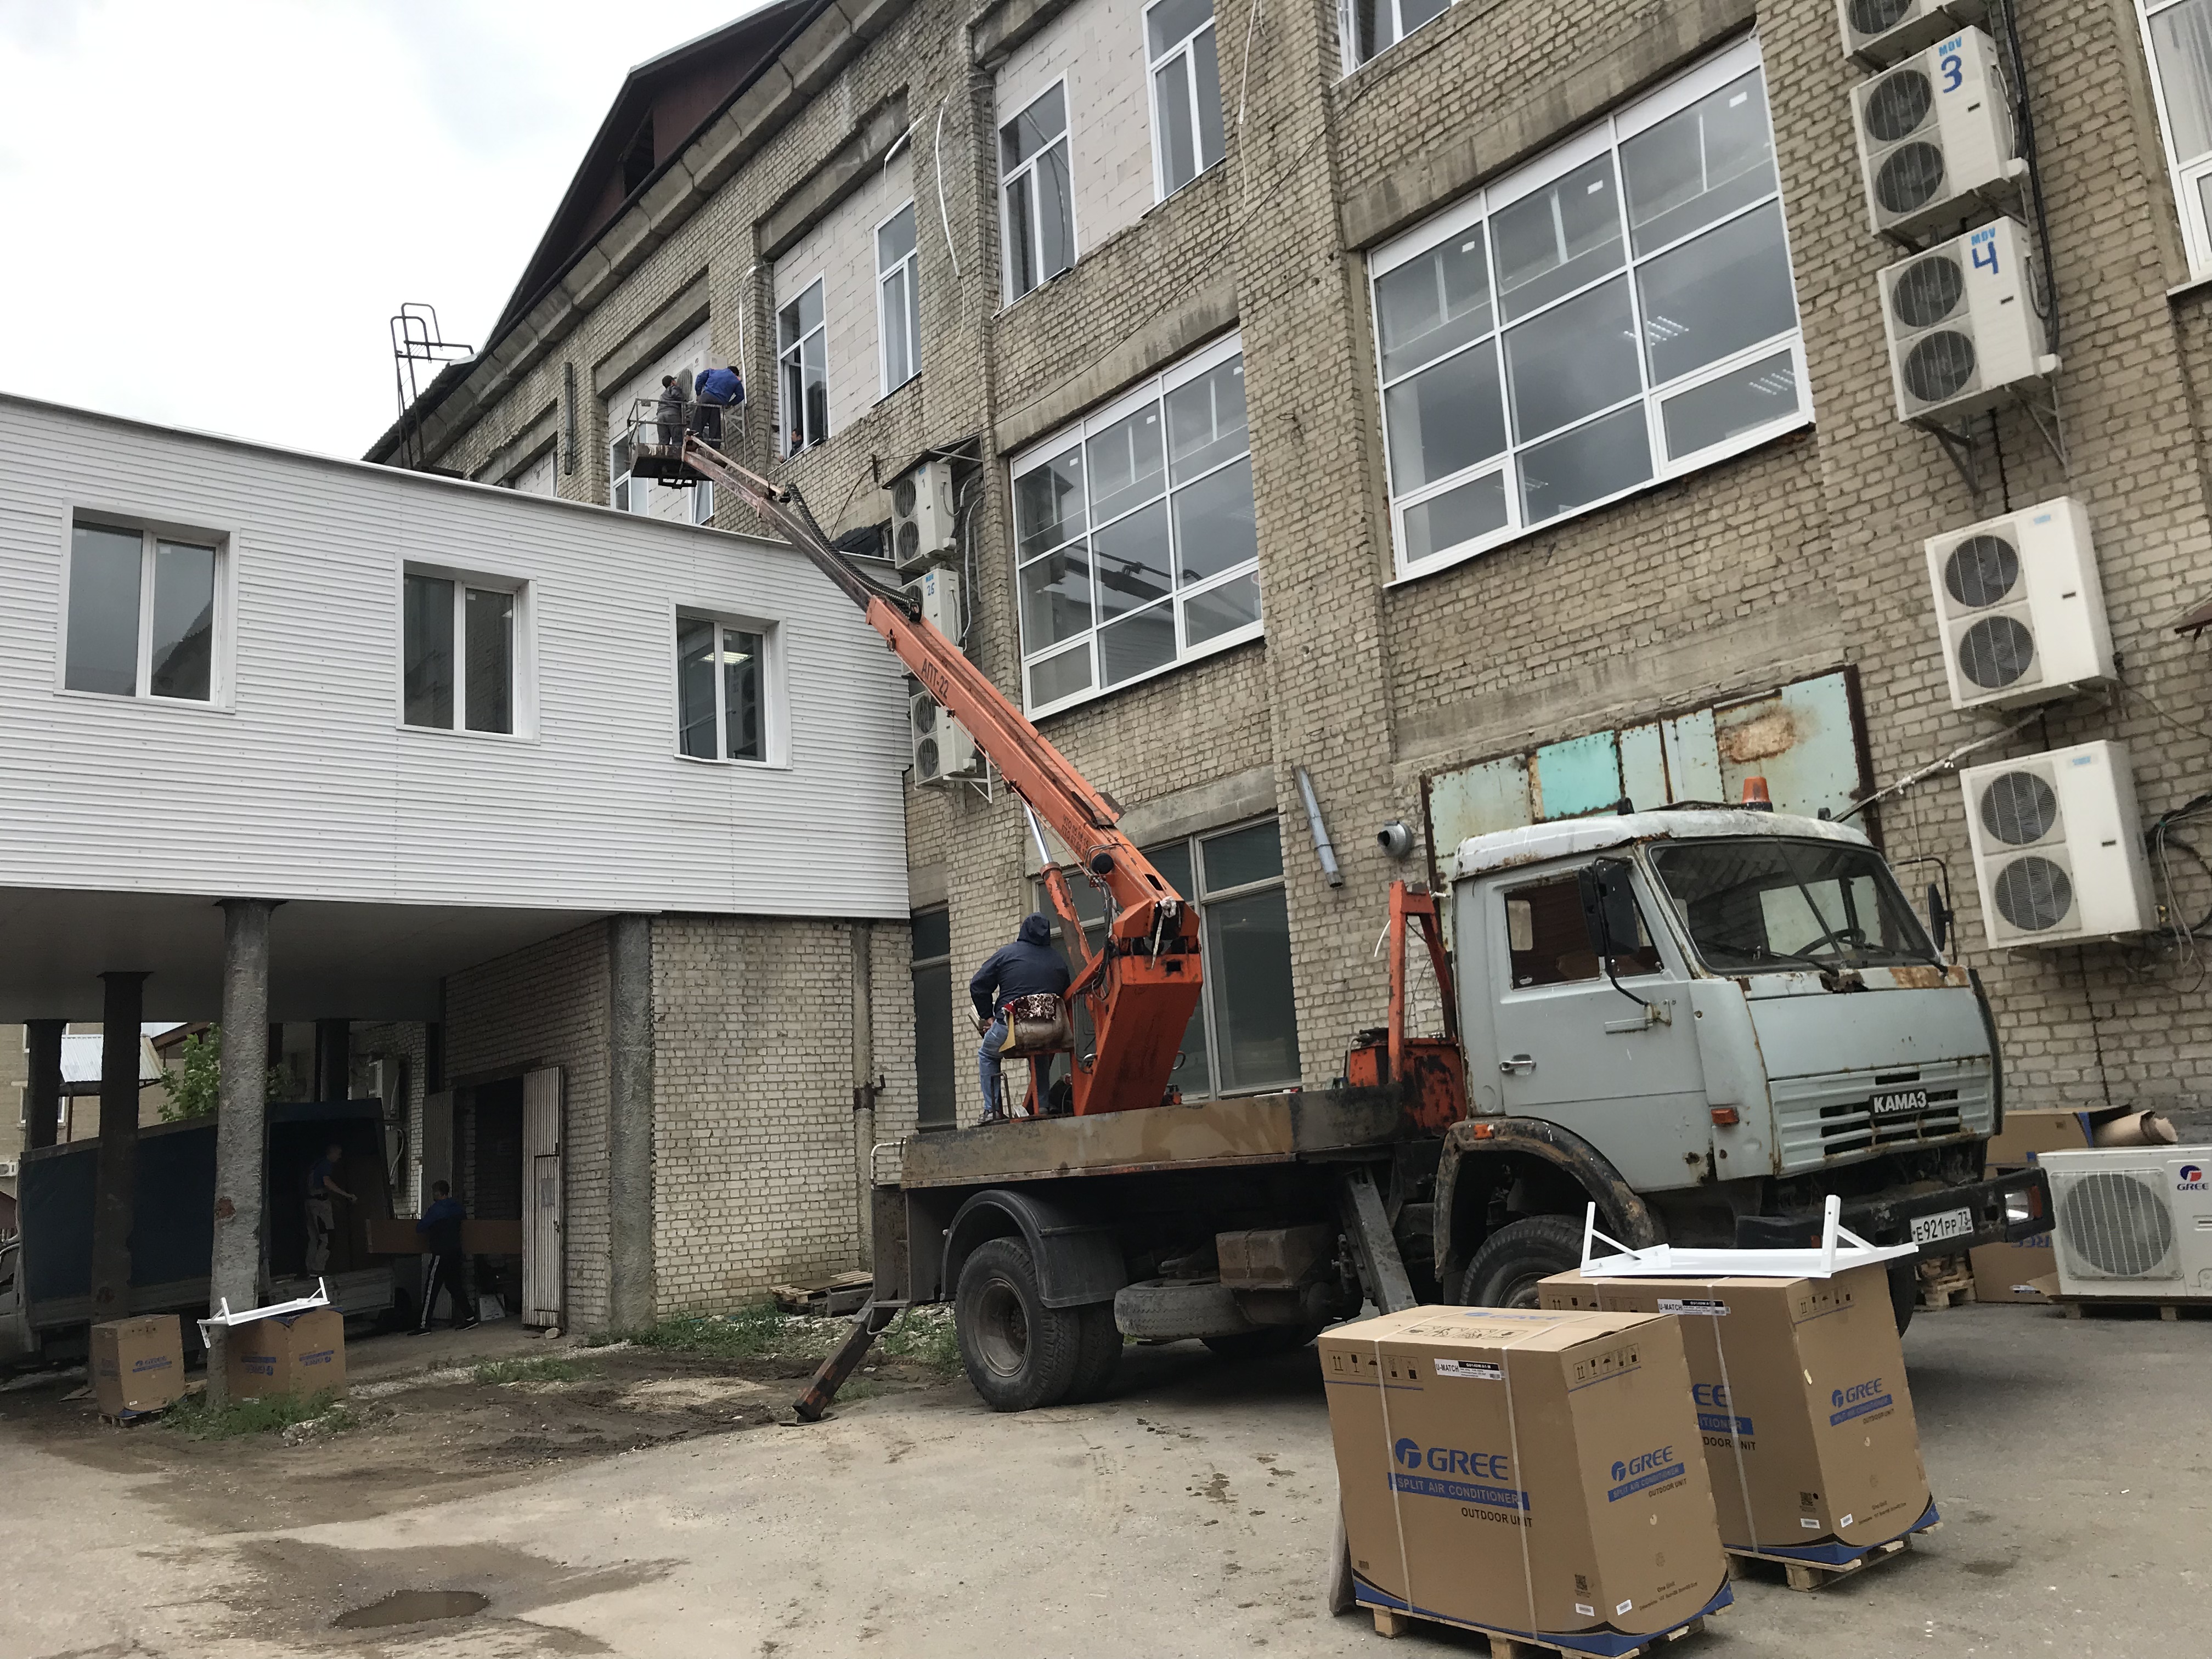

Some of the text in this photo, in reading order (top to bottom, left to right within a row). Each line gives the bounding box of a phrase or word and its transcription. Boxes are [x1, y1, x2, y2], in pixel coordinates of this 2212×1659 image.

[1941, 55, 1963, 93] 3
[1971, 241, 1999, 275] 4
[1874, 1091, 1927, 1113] КАМАЗ
[2176, 1182, 2209, 1191] GREE
[1916, 1217, 1957, 1242] Е921РР
[1435, 1363, 1459, 1373] U-MATCH
[1846, 1378, 1883, 1403] GREE
[1702, 1436, 1756, 1451] DOOR NIT
[1427, 1447, 1508, 1481] GREE
[1629, 1445, 1673, 1475] GREE
[1398, 1477, 1519, 1504] SPLIT AIR CONDITIONER
[1648, 1483, 1675, 1498] OUTDOOR
[1461, 1507, 1509, 1524] OUTDOOR
